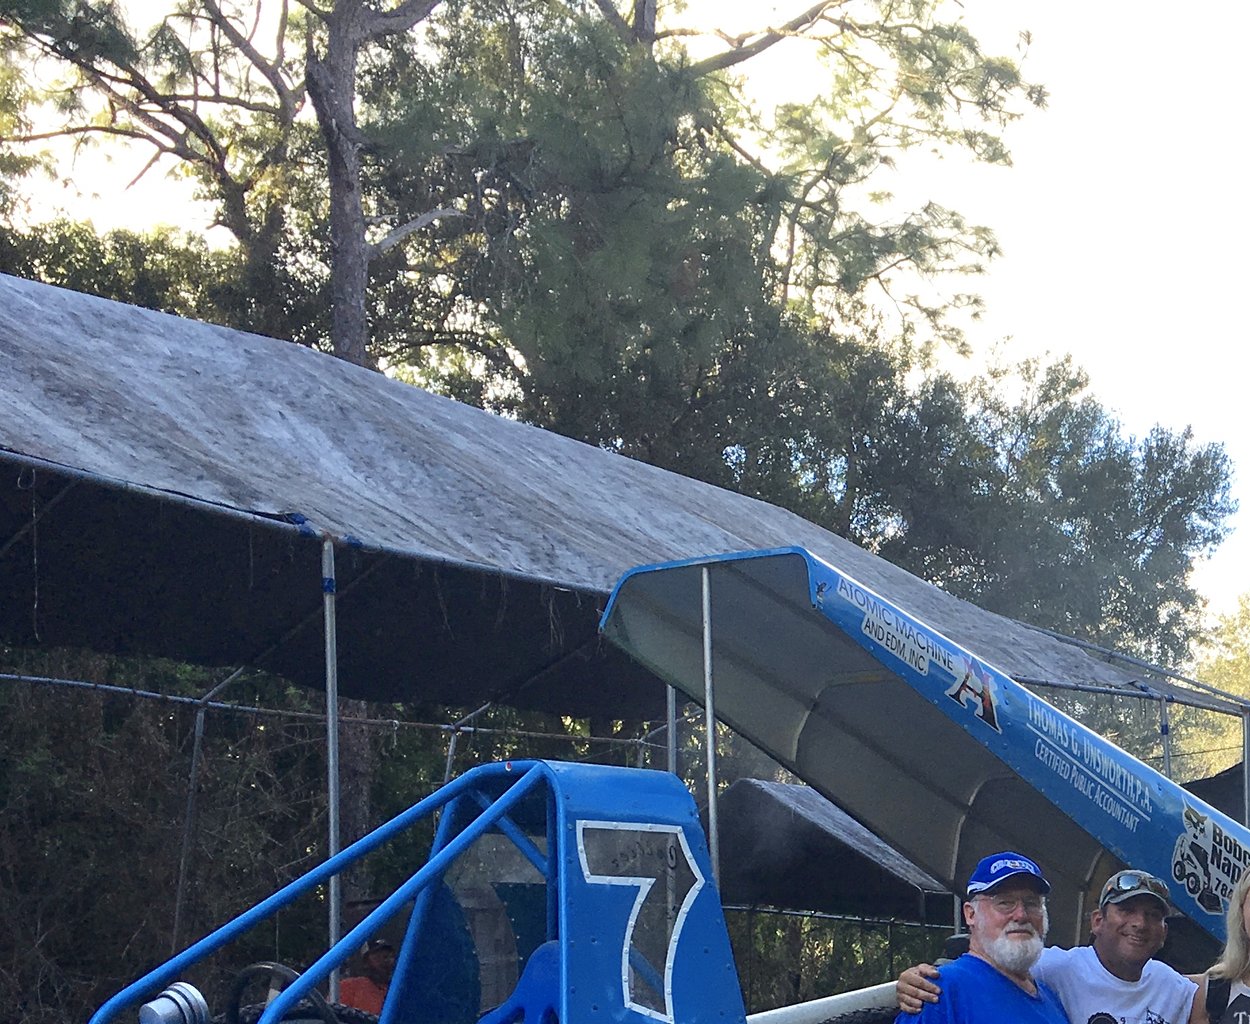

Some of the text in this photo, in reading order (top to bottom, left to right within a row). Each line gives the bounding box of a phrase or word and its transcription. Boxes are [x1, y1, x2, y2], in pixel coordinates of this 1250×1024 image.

[839, 578, 953, 671] ATOMIC MACHINE
[863, 617, 885, 641] AND
[908, 649, 927, 674] INC.
[1025, 692, 1069, 748] THOMAS
[1071, 728, 1081, 757] G.
[1034, 738, 1140, 833] CERTIFIED PUBLIC ACCOUNTANT
[1210, 843, 1245, 885] Nap
[576, 820, 705, 1024] 7
